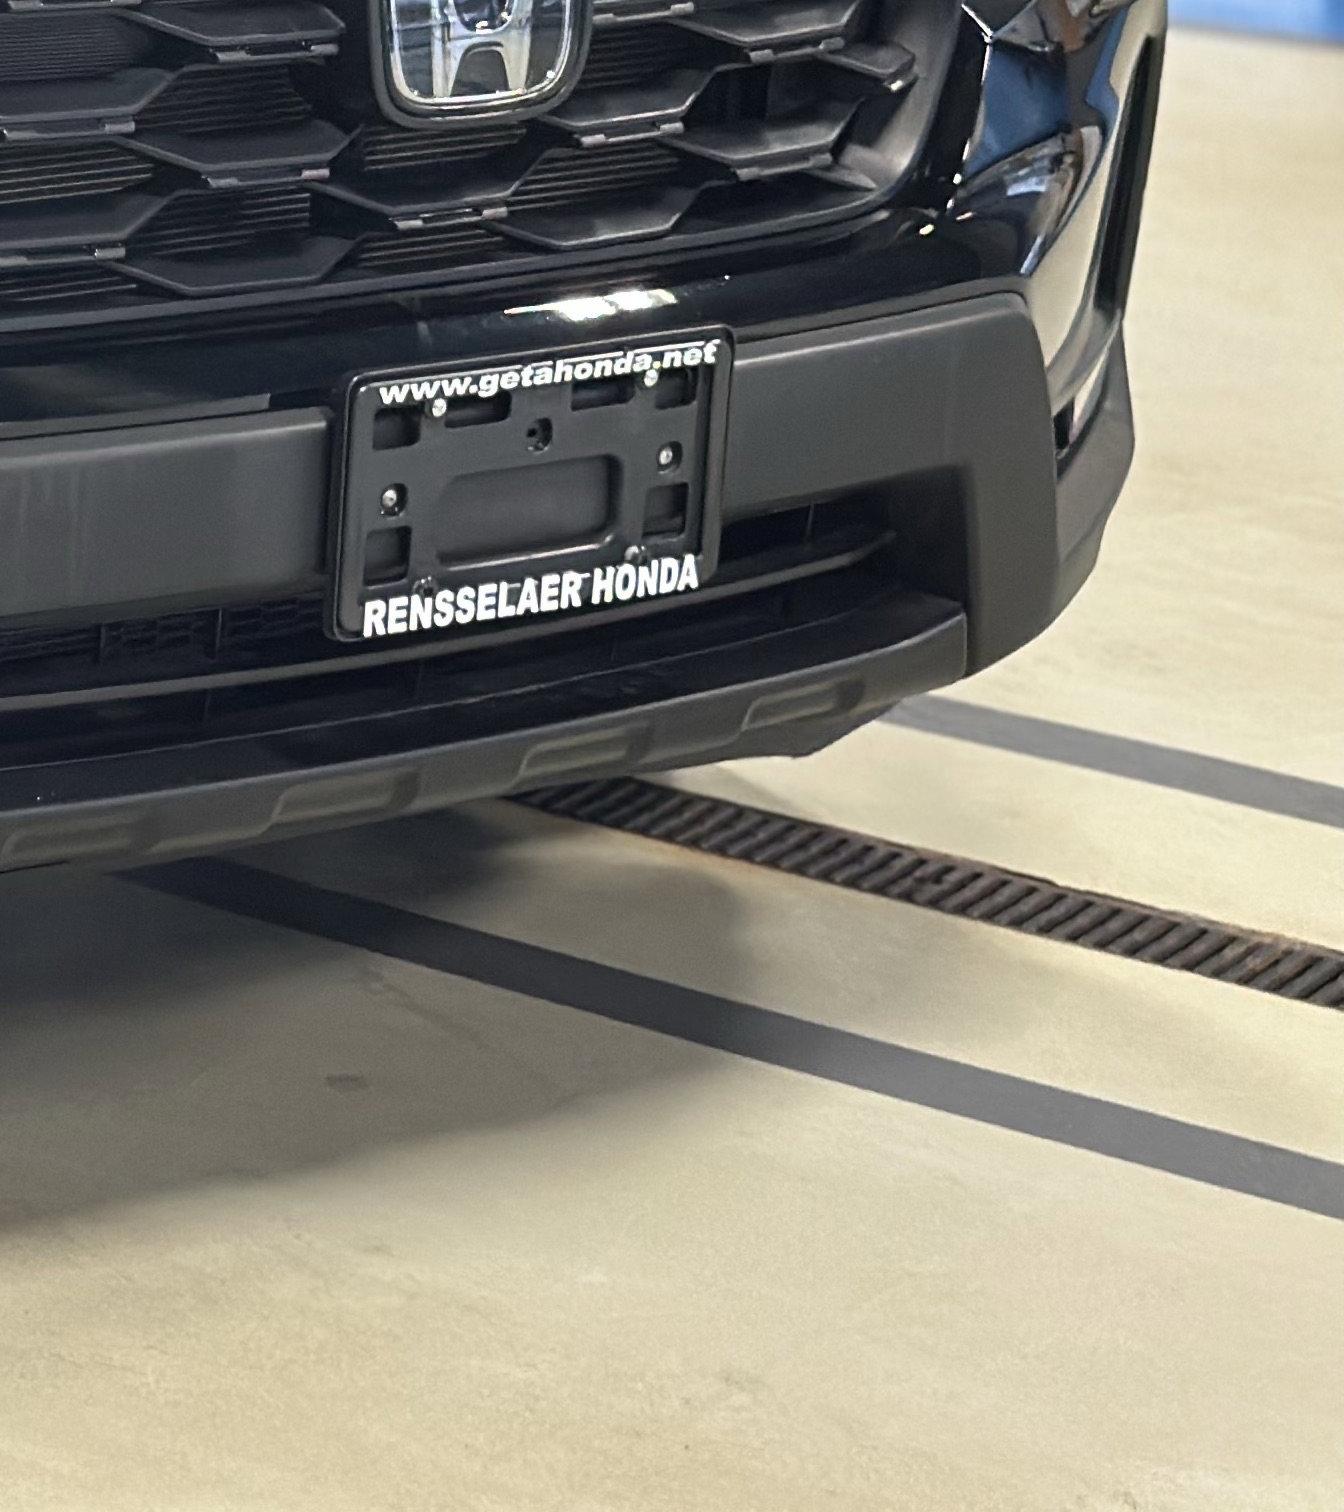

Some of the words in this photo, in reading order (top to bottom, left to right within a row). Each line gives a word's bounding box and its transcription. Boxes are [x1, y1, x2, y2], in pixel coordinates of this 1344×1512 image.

[378, 341, 719, 405] www.getahonda.net
[362, 571, 583, 639] RENSSELAER
[590, 553, 700, 605] HONDA
